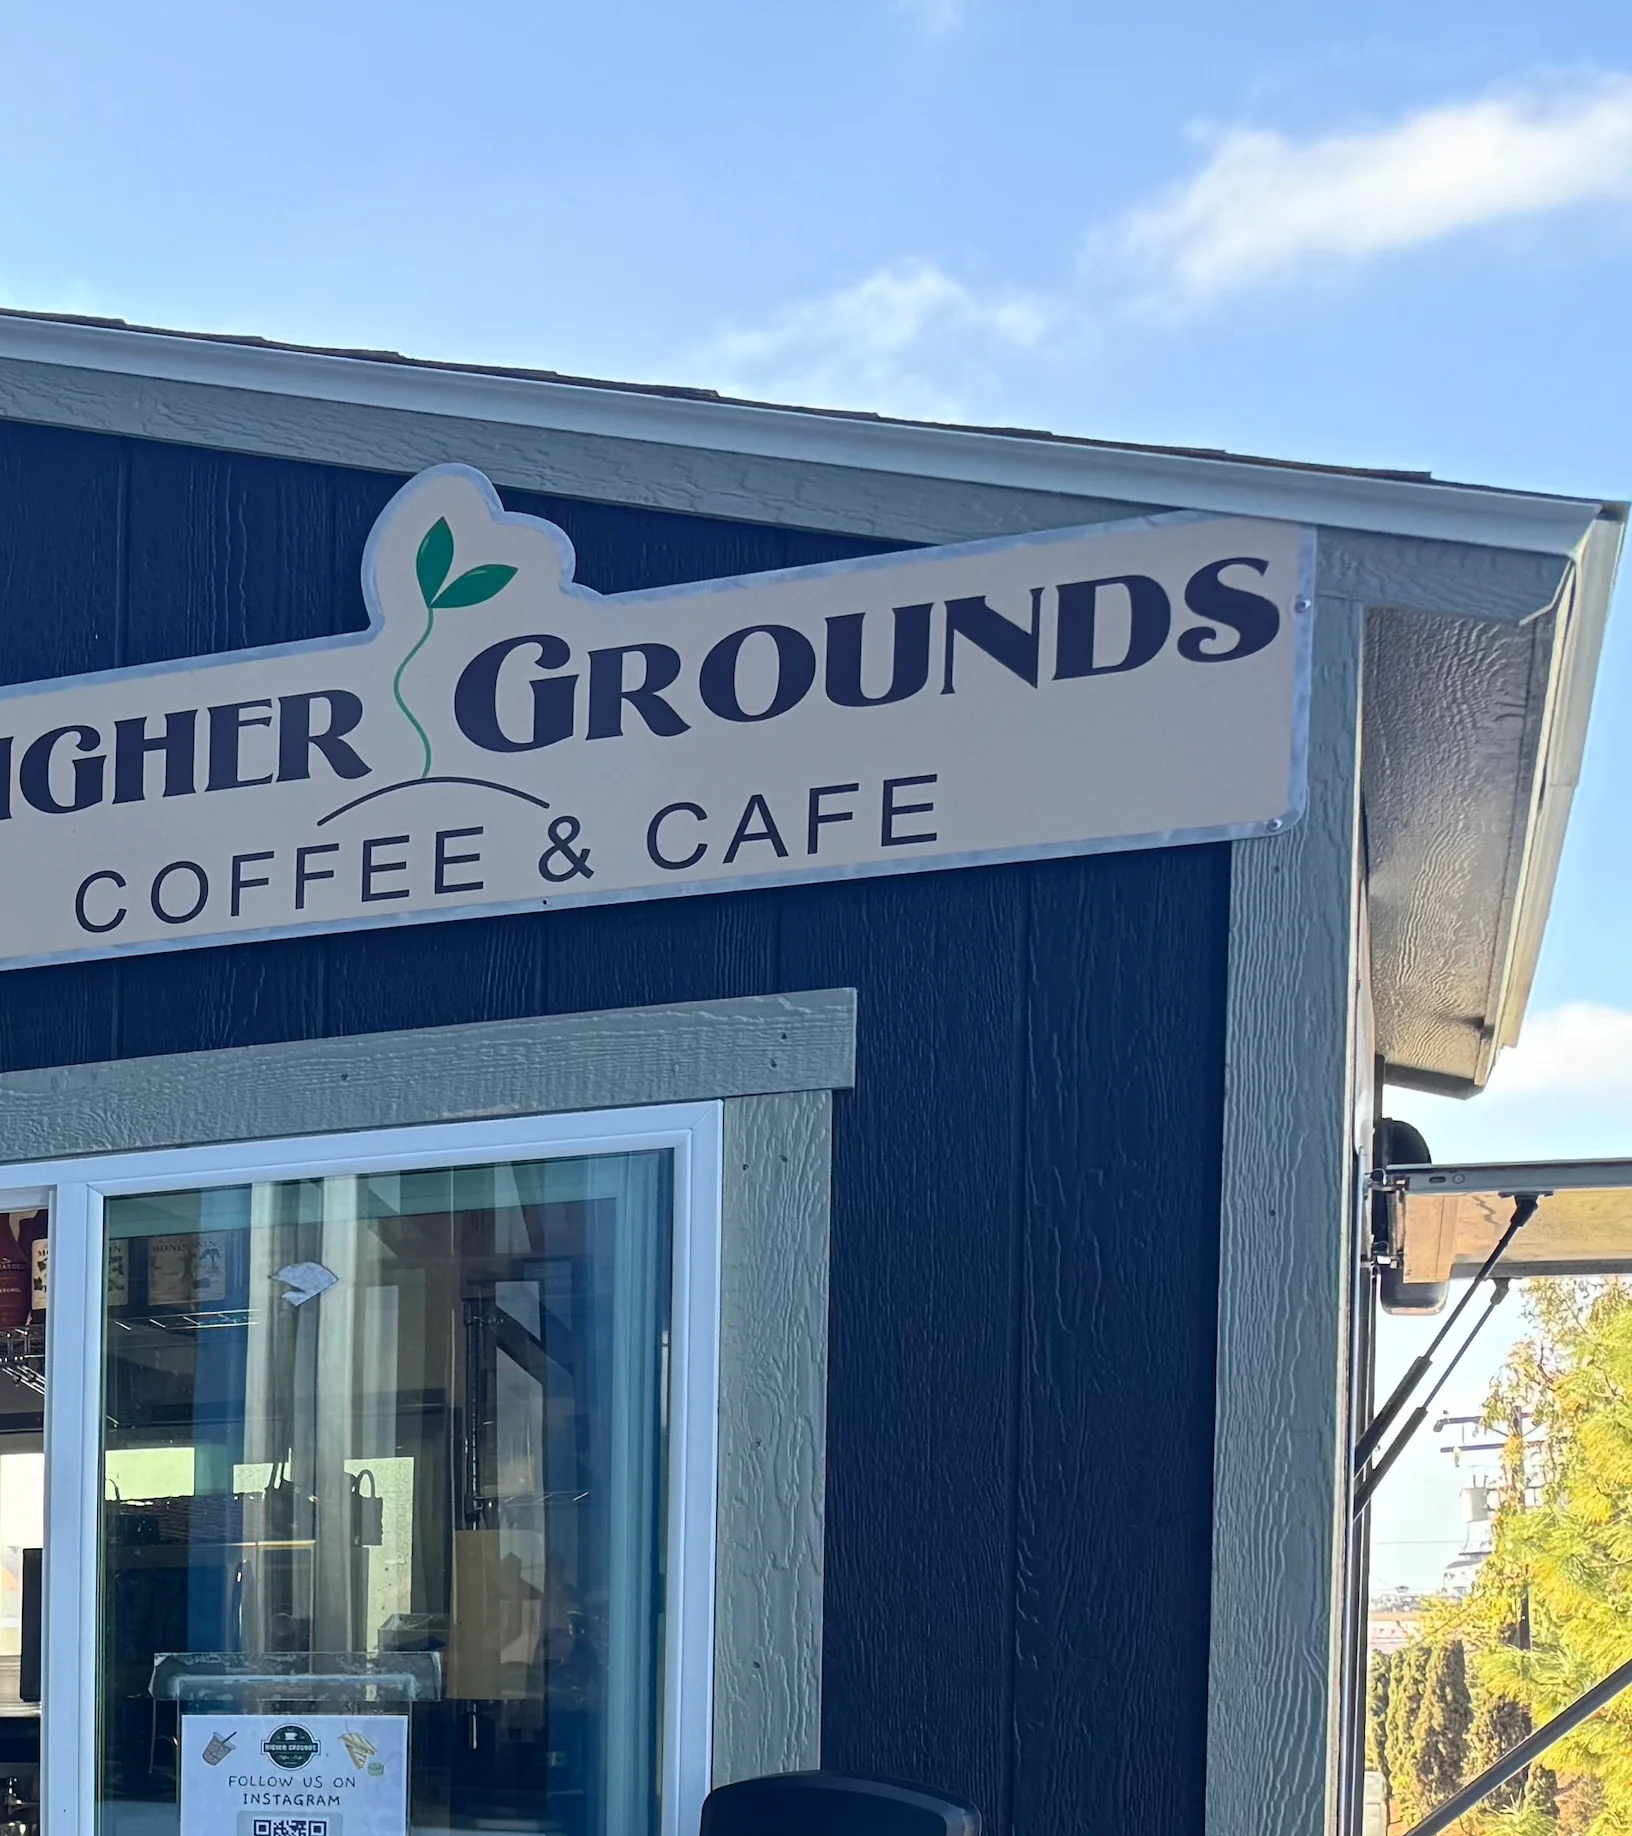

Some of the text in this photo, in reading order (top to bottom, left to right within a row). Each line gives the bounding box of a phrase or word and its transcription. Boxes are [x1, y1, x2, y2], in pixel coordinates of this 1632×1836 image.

[454, 557, 1280, 752] GROUNDS
[76, 774, 937, 933] COFFEE & CAFE
[228, 1776, 356, 1788] FOLLOW US ON
[244, 1793, 340, 1806] INSTAGRAM
